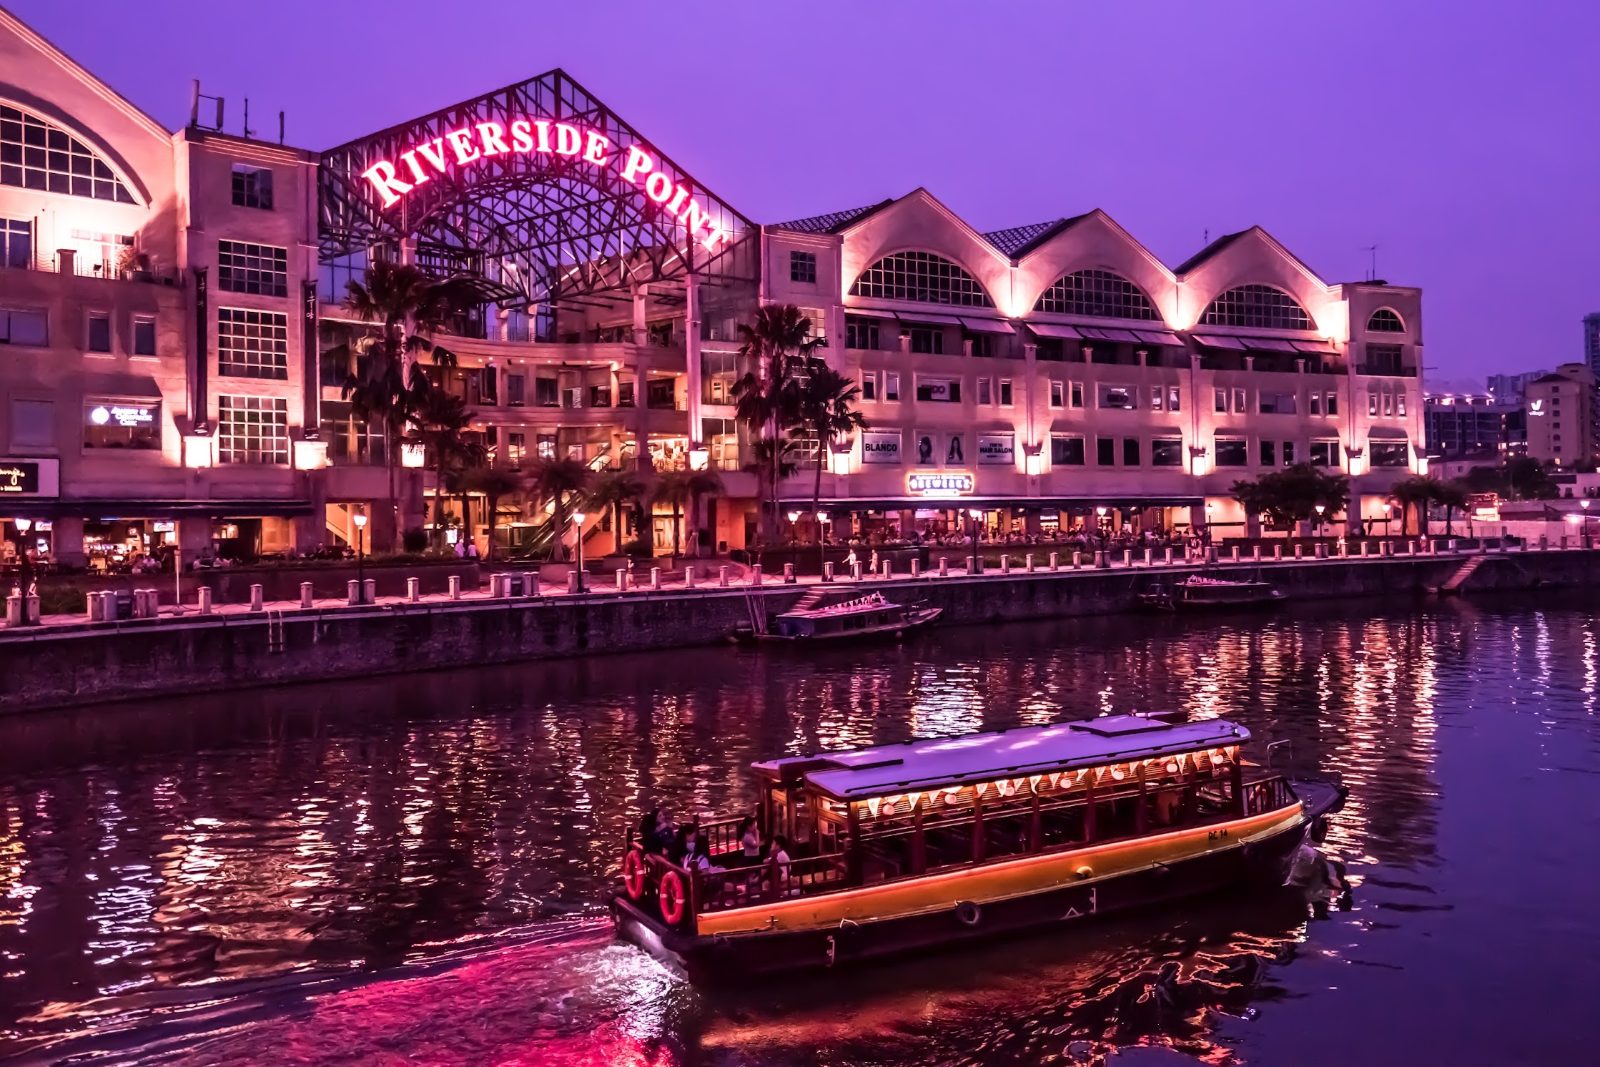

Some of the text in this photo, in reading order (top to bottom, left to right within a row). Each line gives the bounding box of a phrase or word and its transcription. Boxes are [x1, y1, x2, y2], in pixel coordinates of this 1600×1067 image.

[361, 119, 730, 253] RIVERSIDE POINT
[865, 443, 897, 452] BLANCO
